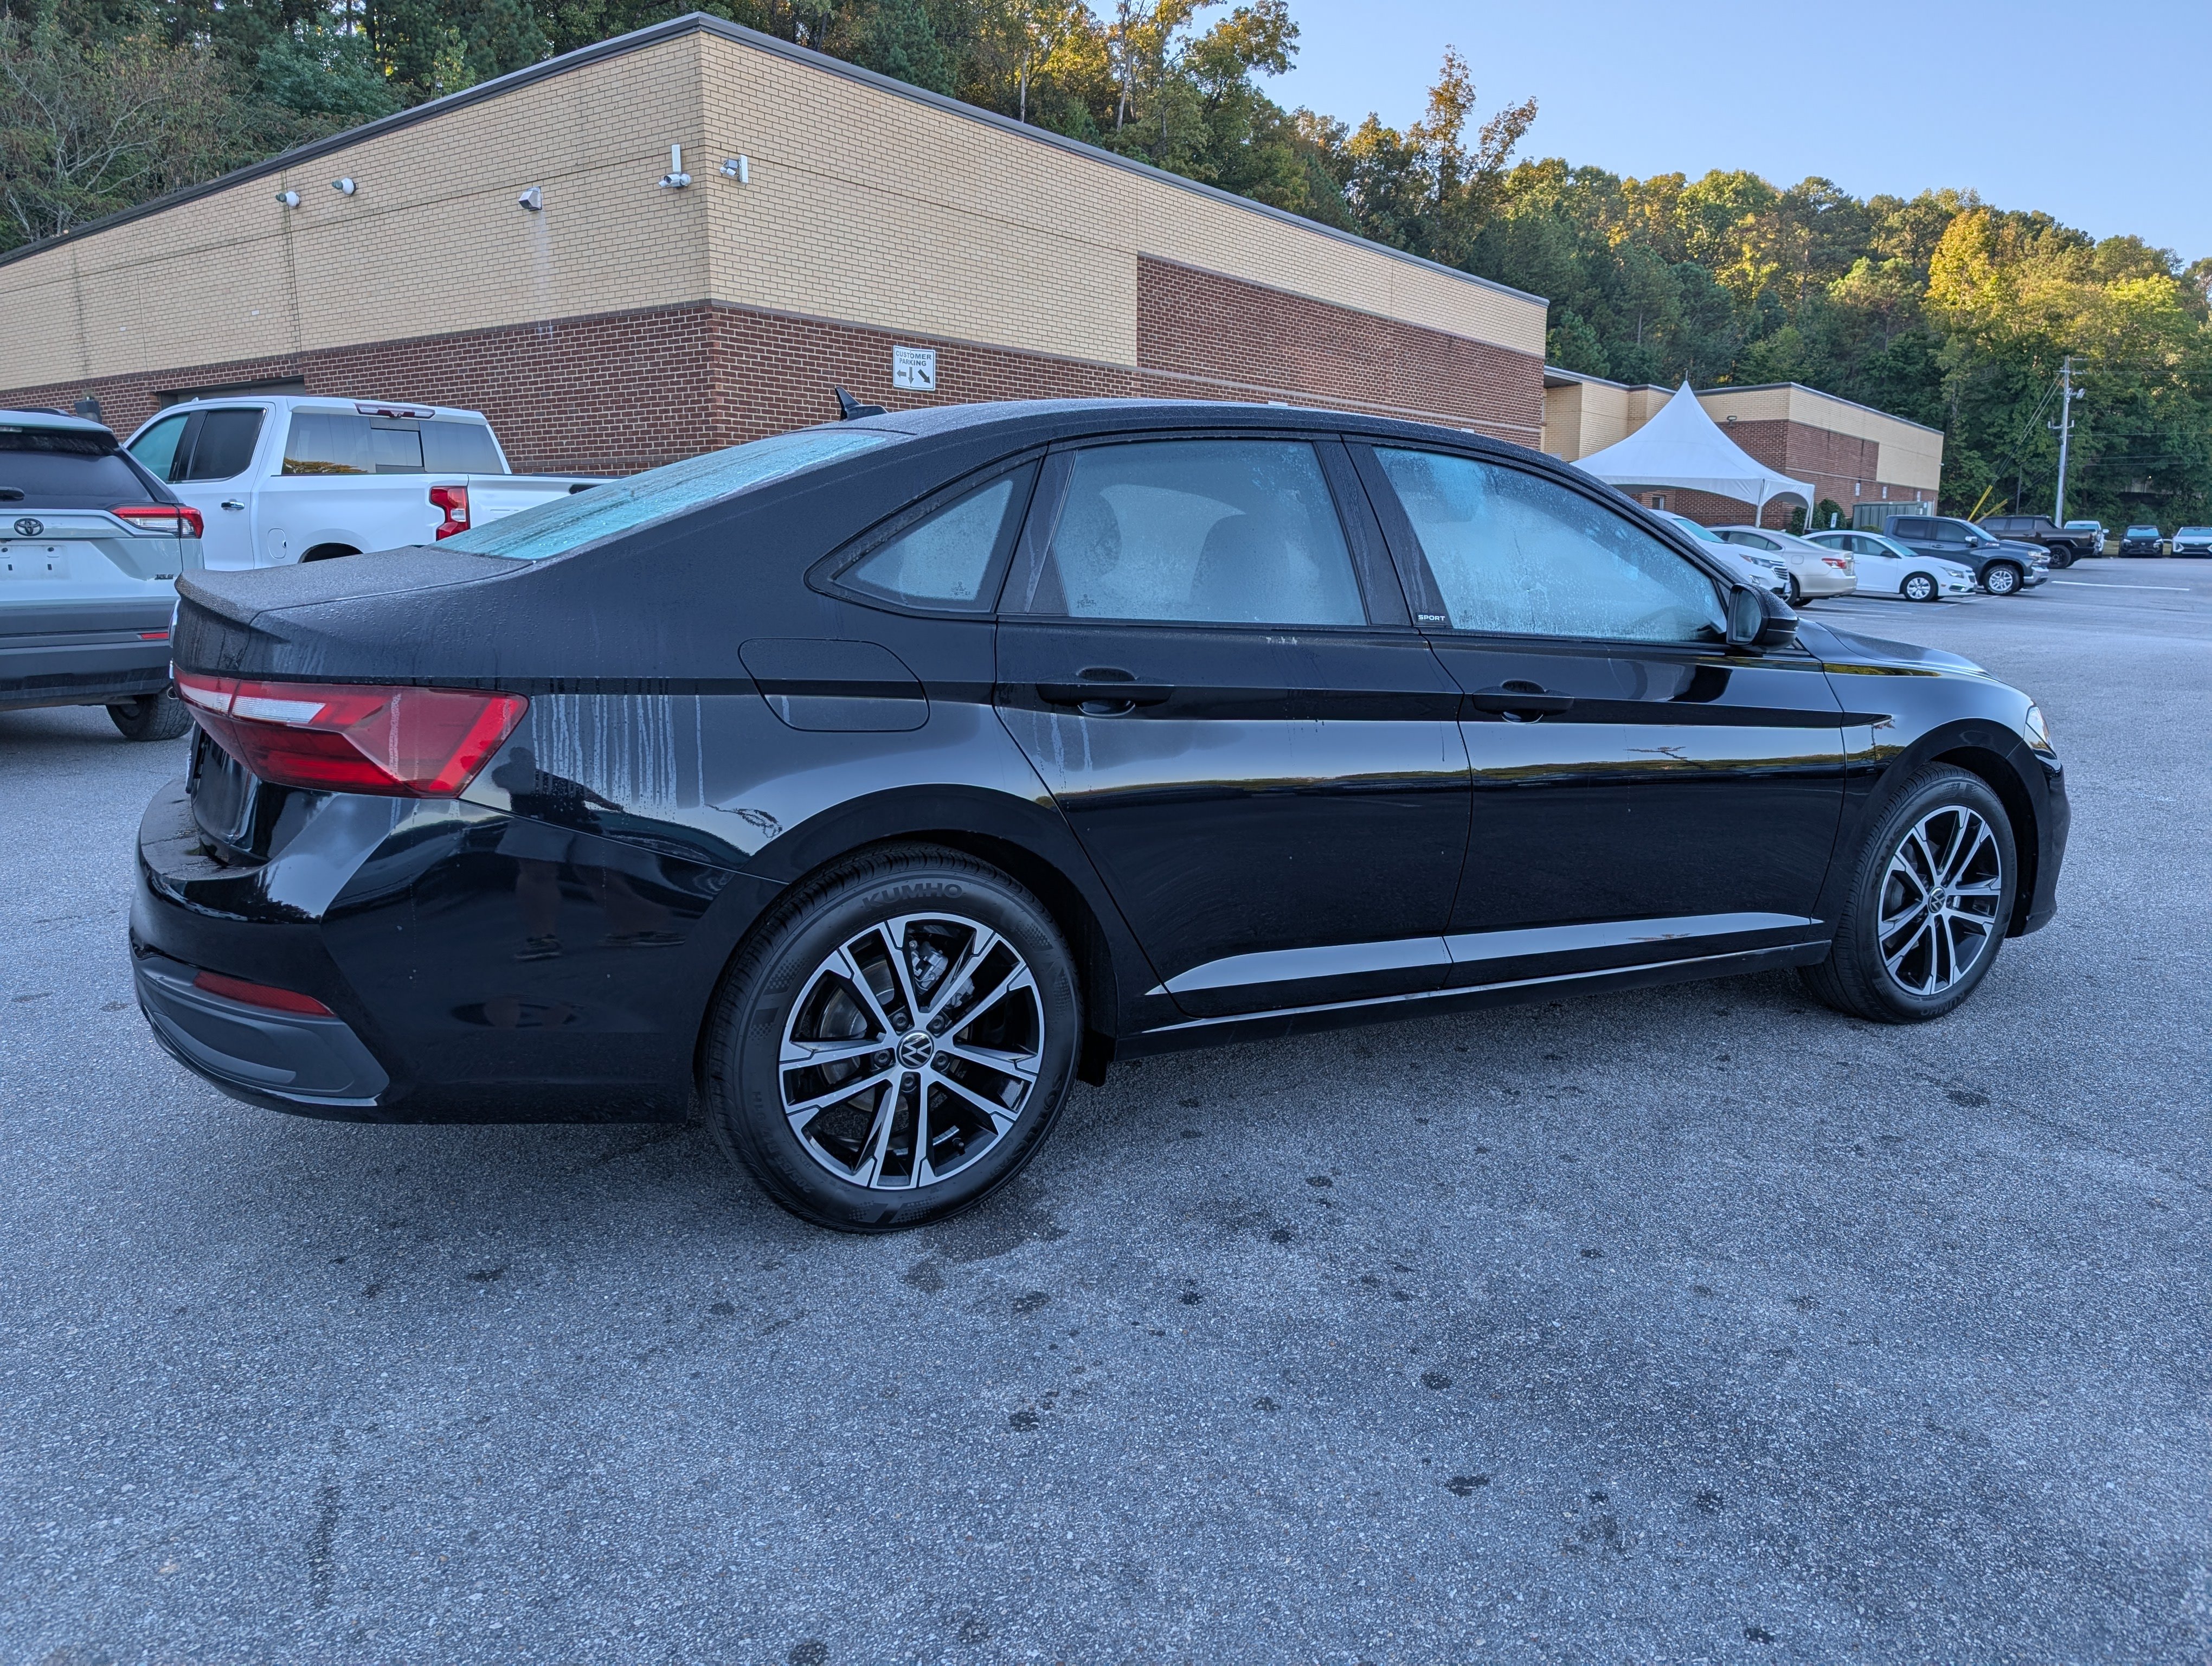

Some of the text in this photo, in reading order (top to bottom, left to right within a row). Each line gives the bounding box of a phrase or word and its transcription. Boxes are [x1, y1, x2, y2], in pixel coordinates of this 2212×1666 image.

[896, 351, 931, 360] CUSTOMER
[899, 358, 927, 366] PARKING
[862, 882, 963, 911] KUMHO
